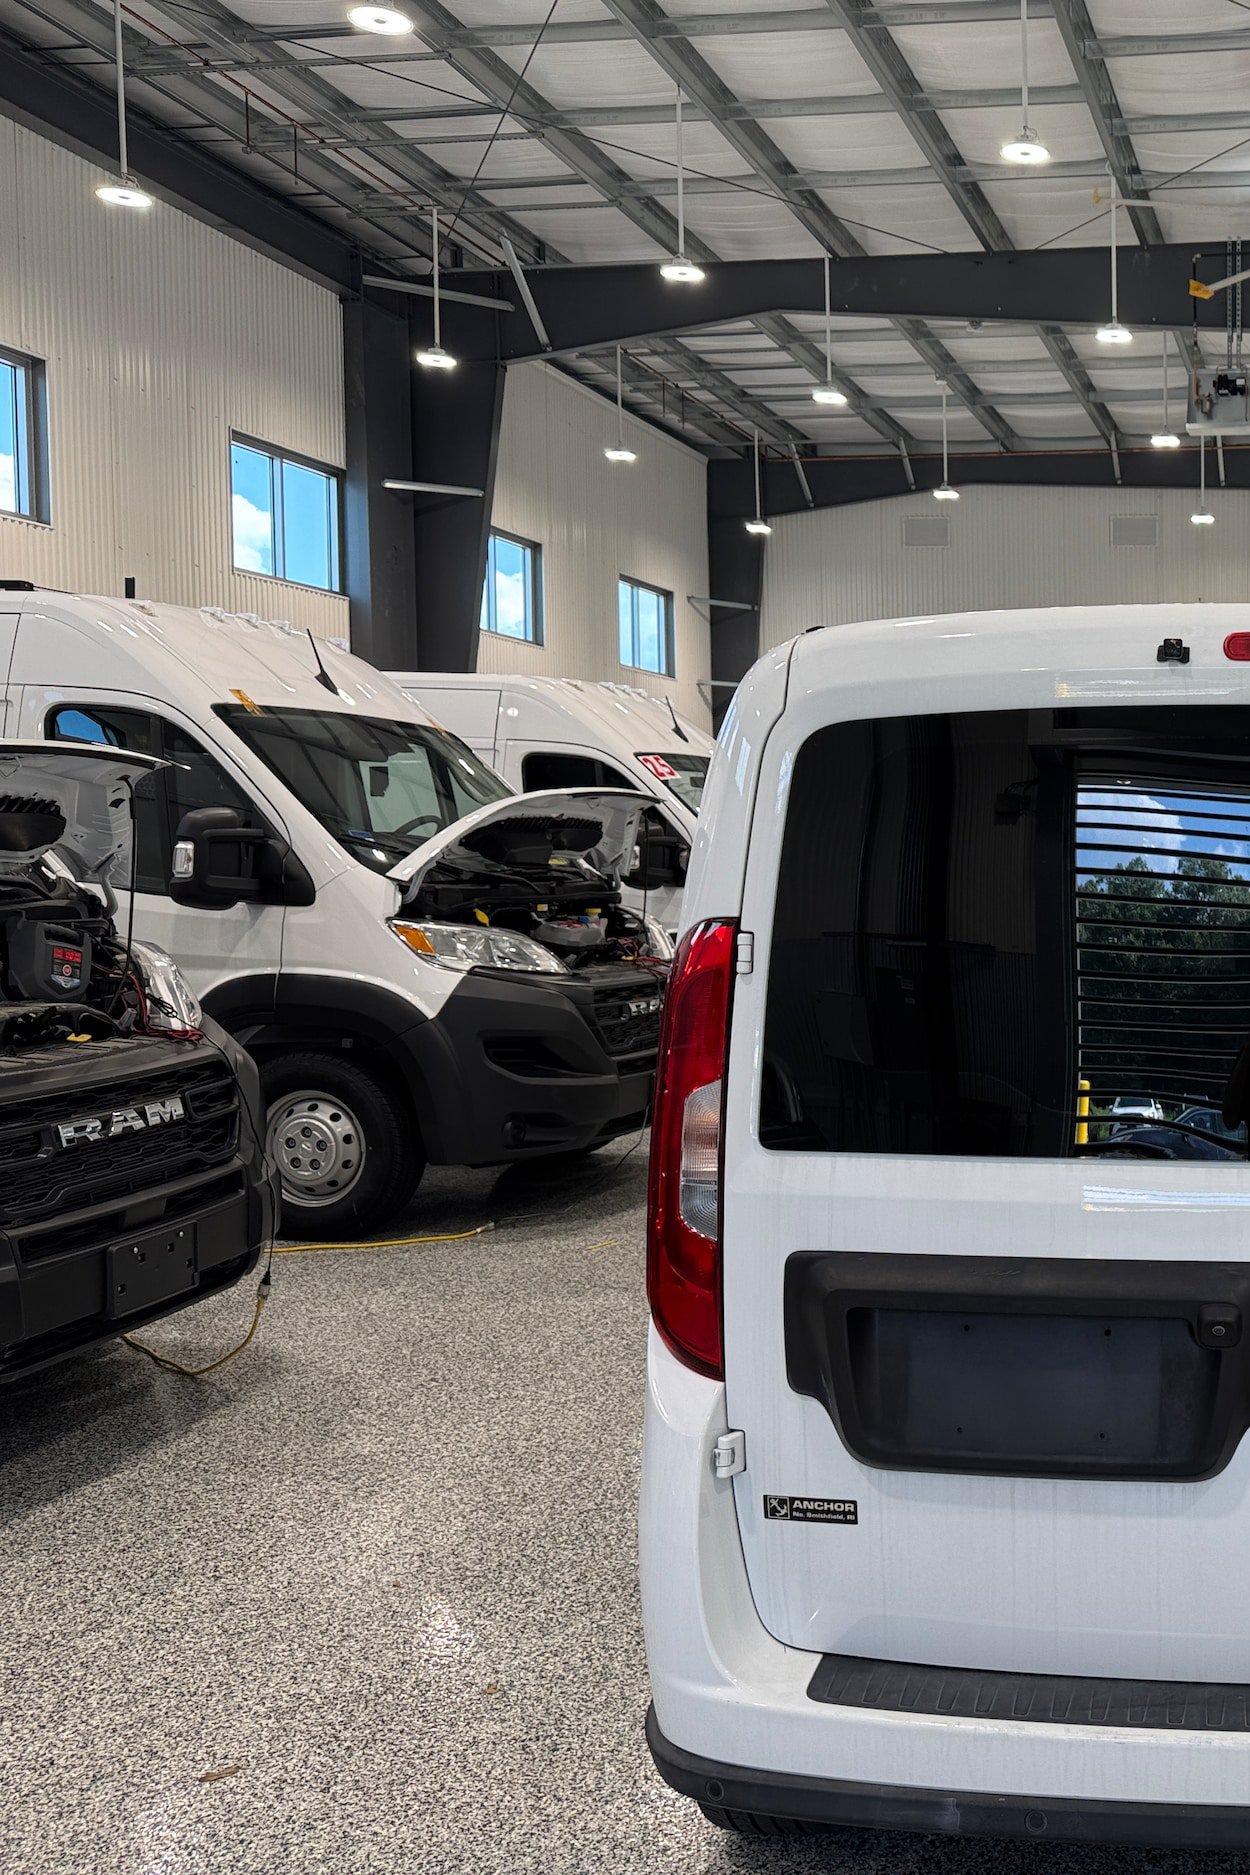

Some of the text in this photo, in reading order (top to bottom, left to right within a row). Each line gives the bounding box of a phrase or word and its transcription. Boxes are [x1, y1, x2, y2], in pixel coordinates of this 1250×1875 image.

[642, 756, 675, 777] 25
[58, 1097, 184, 1147] RAM
[793, 1500, 855, 1511] ANCHOR
